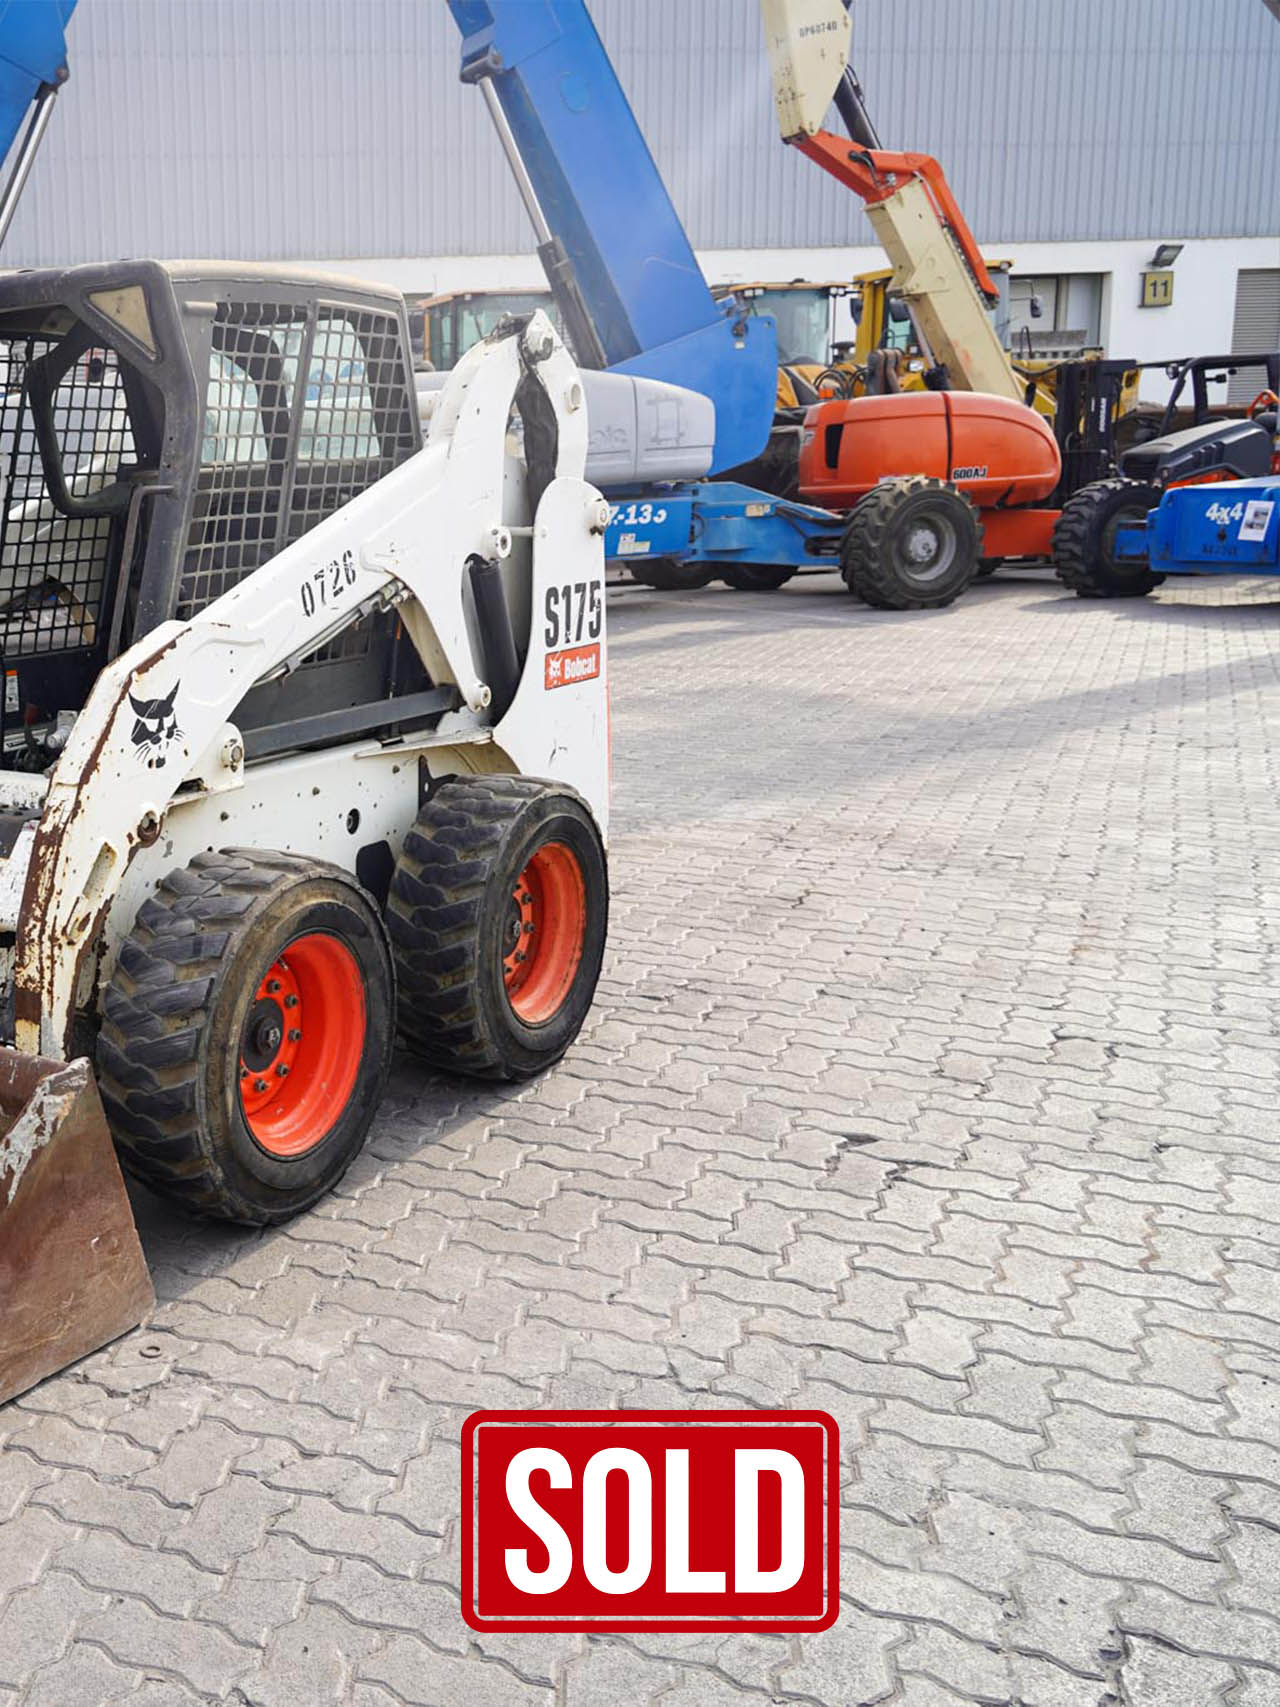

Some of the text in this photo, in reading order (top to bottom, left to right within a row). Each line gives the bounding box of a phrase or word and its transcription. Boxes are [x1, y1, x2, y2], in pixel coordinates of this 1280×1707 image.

[1149, 279, 1169, 297] 11
[301, 549, 356, 617] 0726
[545, 580, 600, 648] S175
[564, 653, 596, 680] Bobcat
